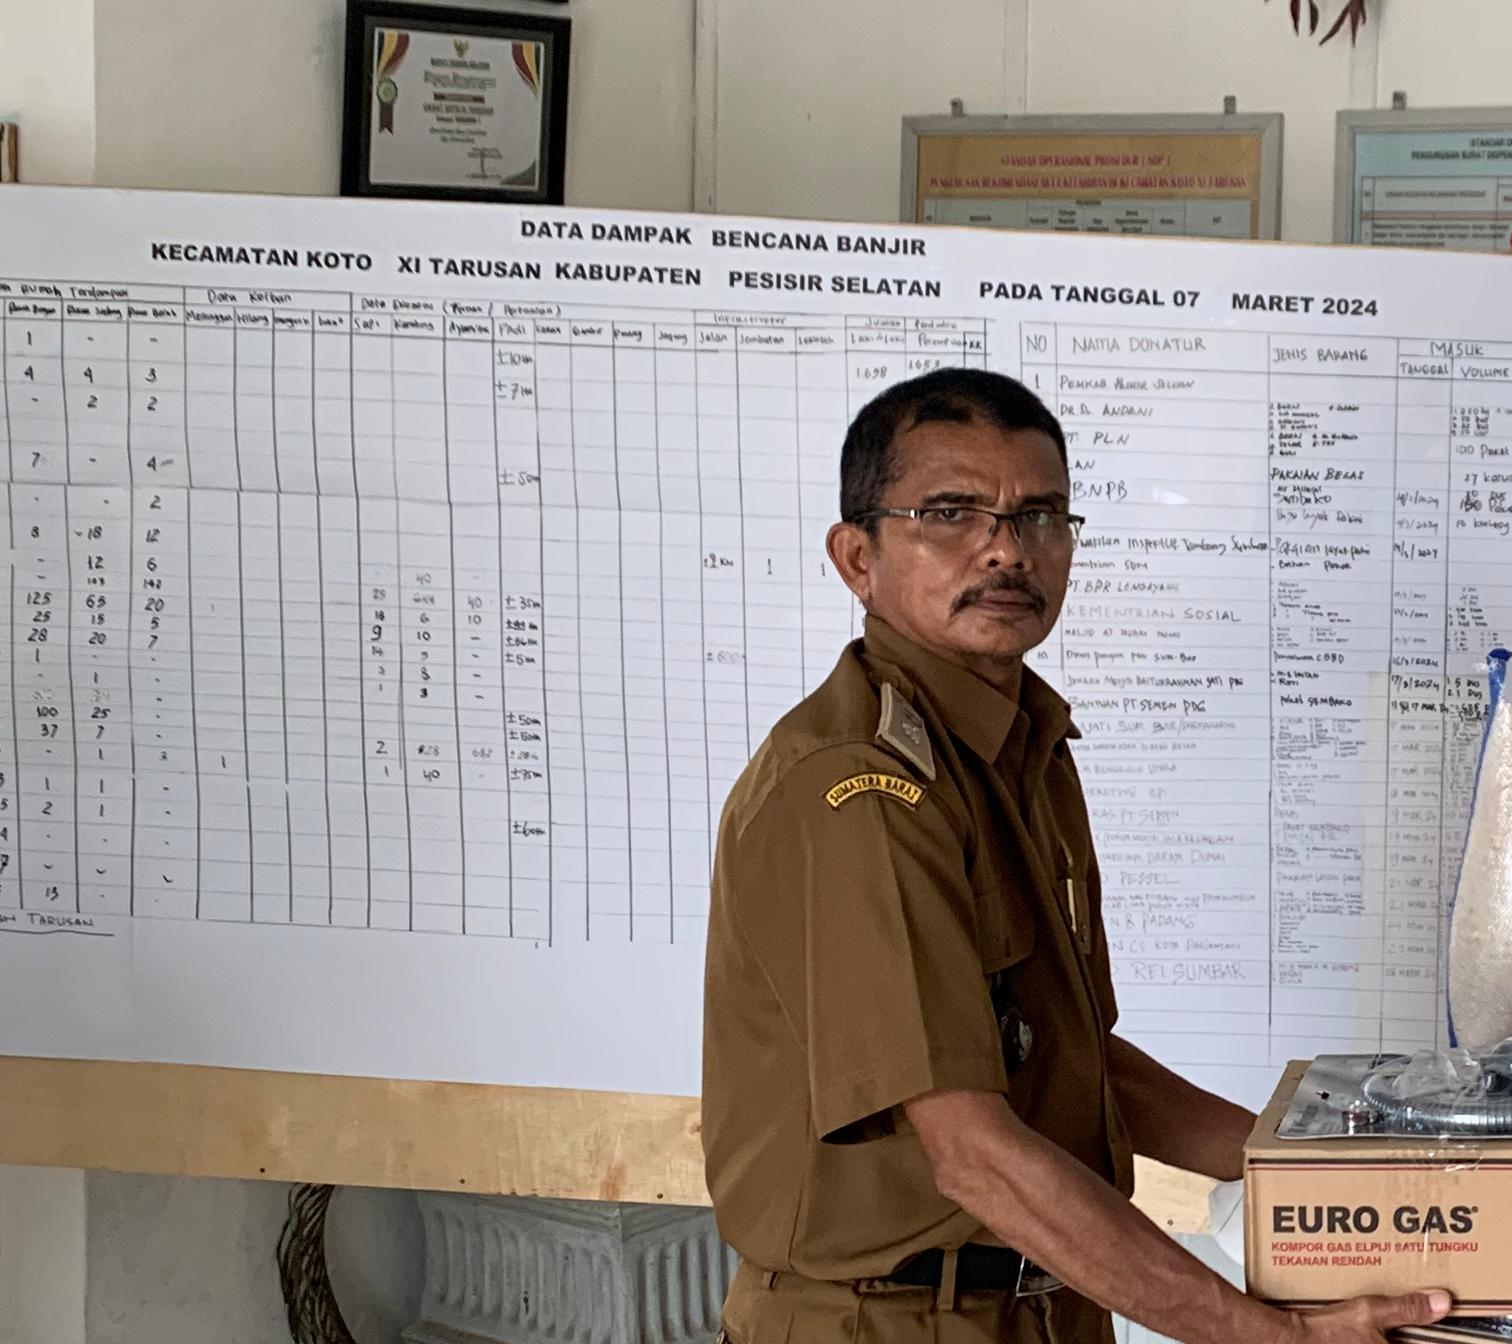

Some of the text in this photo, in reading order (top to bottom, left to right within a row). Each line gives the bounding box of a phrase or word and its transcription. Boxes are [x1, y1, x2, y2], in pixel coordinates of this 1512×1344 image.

[520, 220, 926, 257] DATA DAMPAK BENCANA BANJIR
[151, 242, 1379, 317] KECAMATAN KOTO XI TARUSAN KABUPATEN PESISIR SELATAN PADA TANGGAL 07 MARET 2024
[1026, 334, 1048, 353] NO
[1129, 337, 1207, 353] DONATUR
[1430, 341, 1484, 357] MASUK
[1400, 362, 1449, 375] TANGGAL
[1461, 365, 1510, 379] VOLUME
[1093, 431, 1130, 446] PLN
[1072, 480, 1128, 502] BNPB
[27, 591, 52, 605] 125
[144, 598, 165, 612] 20
[1183, 607, 1242, 622] SOSIAL
[27, 628, 48, 642] 28
[88, 632, 106, 645] 20
[91, 707, 111, 719] 25
[829, 775, 919, 803] SUMATERA BARAT
[1272, 1205, 1474, 1234] EURO GAS
[1271, 1241, 1479, 1253] KOMPOR GAS ELPIJI SATU TUNGKU
[1271, 1255, 1382, 1267] TEKANAN RENDAH
